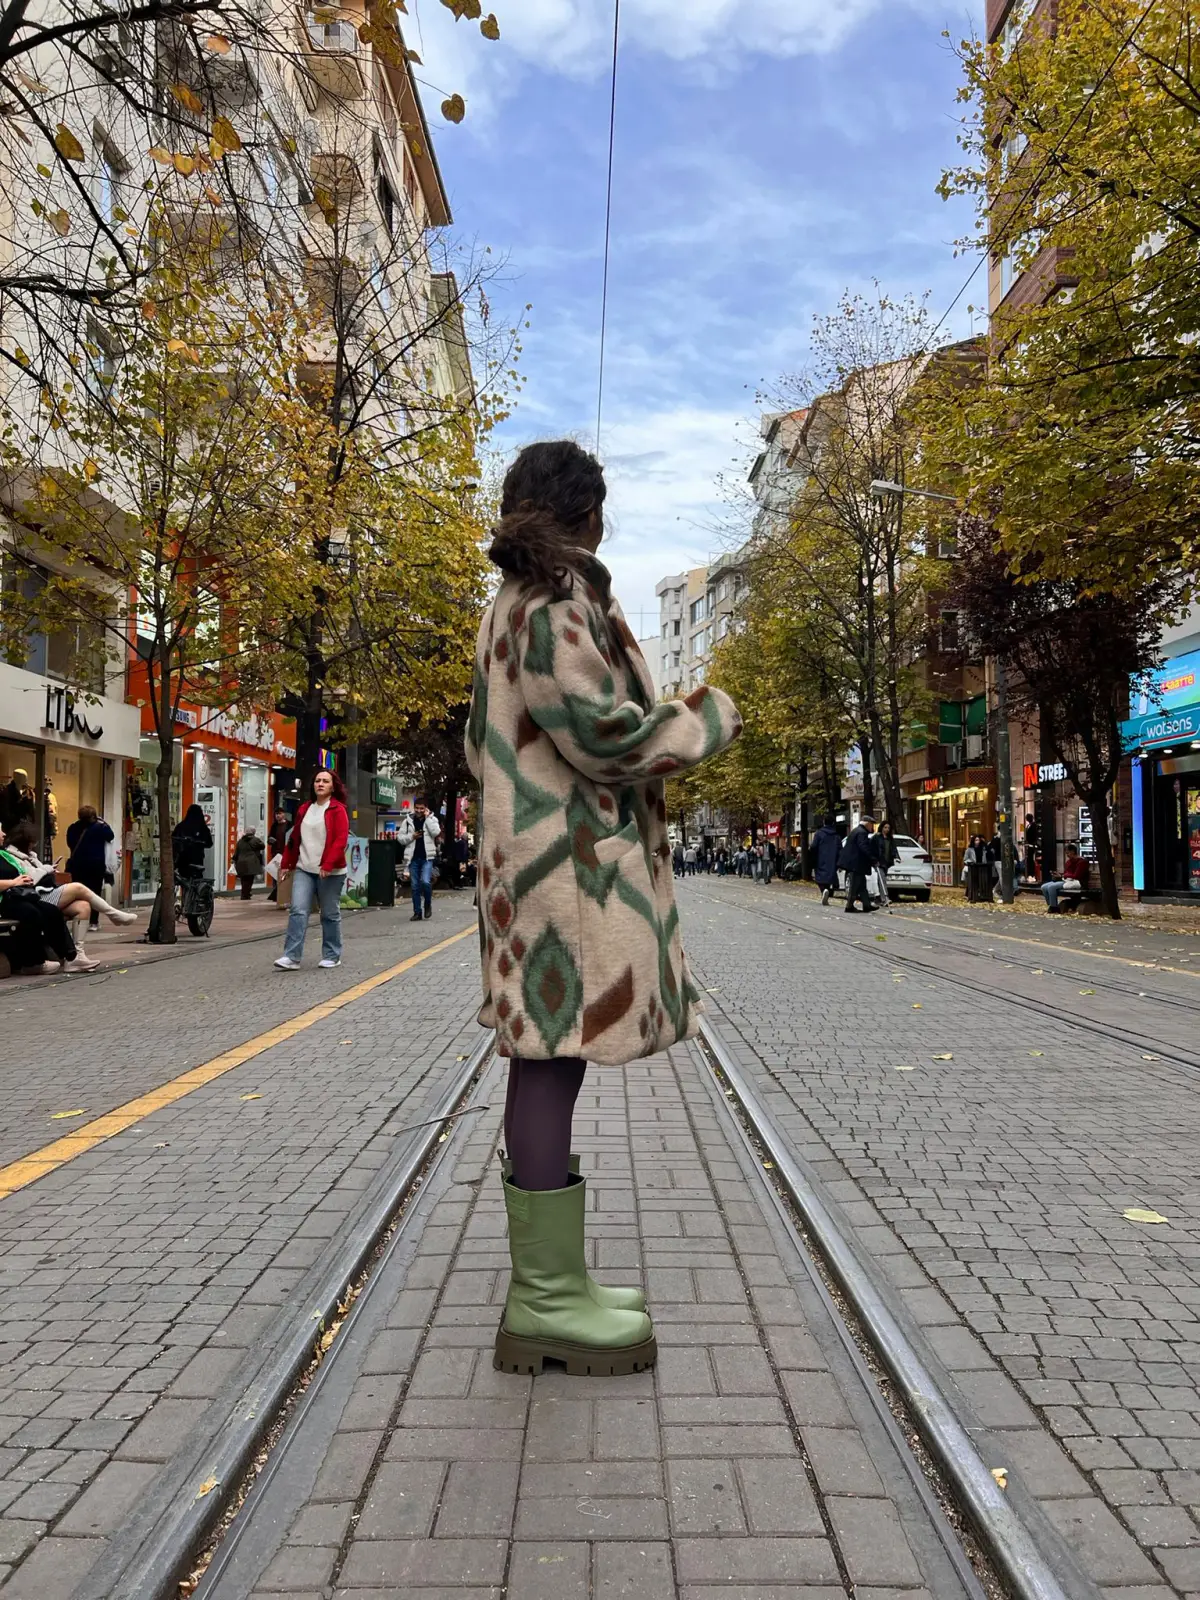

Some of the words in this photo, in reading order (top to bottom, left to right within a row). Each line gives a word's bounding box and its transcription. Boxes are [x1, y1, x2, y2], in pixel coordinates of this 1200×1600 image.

[46, 685, 75, 733] LTB
[1146, 717, 1192, 738] watsons
[1024, 764, 1039, 789] IN
